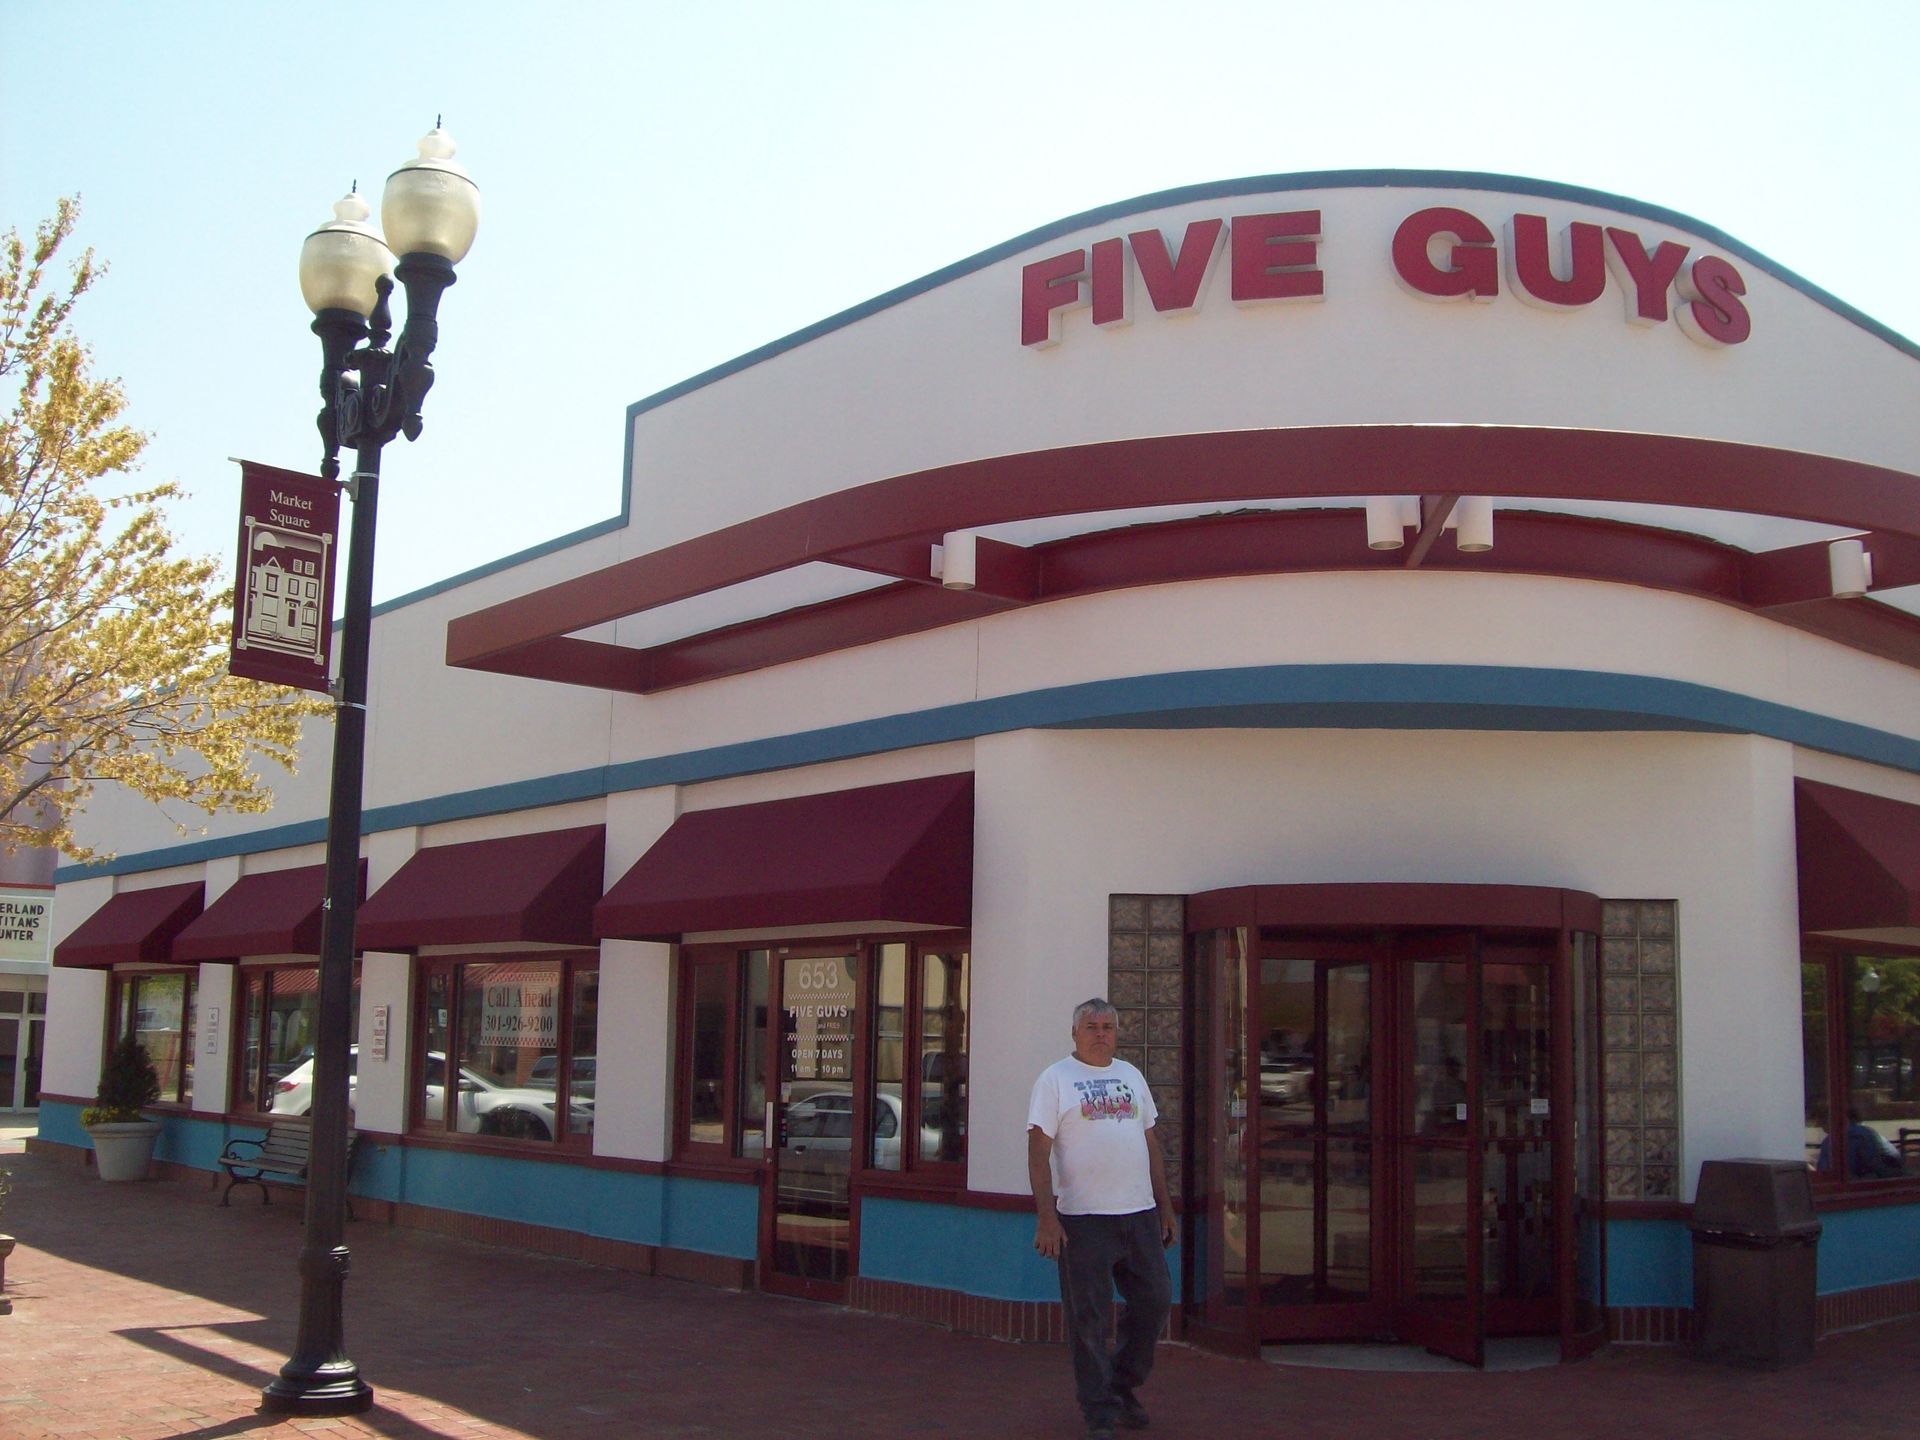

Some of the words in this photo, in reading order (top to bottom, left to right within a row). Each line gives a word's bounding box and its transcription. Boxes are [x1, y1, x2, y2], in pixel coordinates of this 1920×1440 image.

[1021, 209, 1324, 349] FIVE
[1391, 206, 1751, 348] GUYS
[270, 489, 313, 511] Market
[269, 508, 311, 529] Square
[798, 960, 839, 989] 653
[487, 986, 510, 1008] Call
[513, 986, 552, 1008] Ahead
[788, 1005, 814, 1019] FIVE
[816, 1004, 848, 1018] GUYS
[485, 1015, 553, 1033] 301-926-9200
[791, 1049, 813, 1060] OPEN
[815, 1049, 820, 1059] 7
[821, 1049, 844, 1060] DAYS
[790, 1064, 797, 1073] 11
[822, 1064, 831, 1073] 10
[831, 1065, 844, 1075] pm
